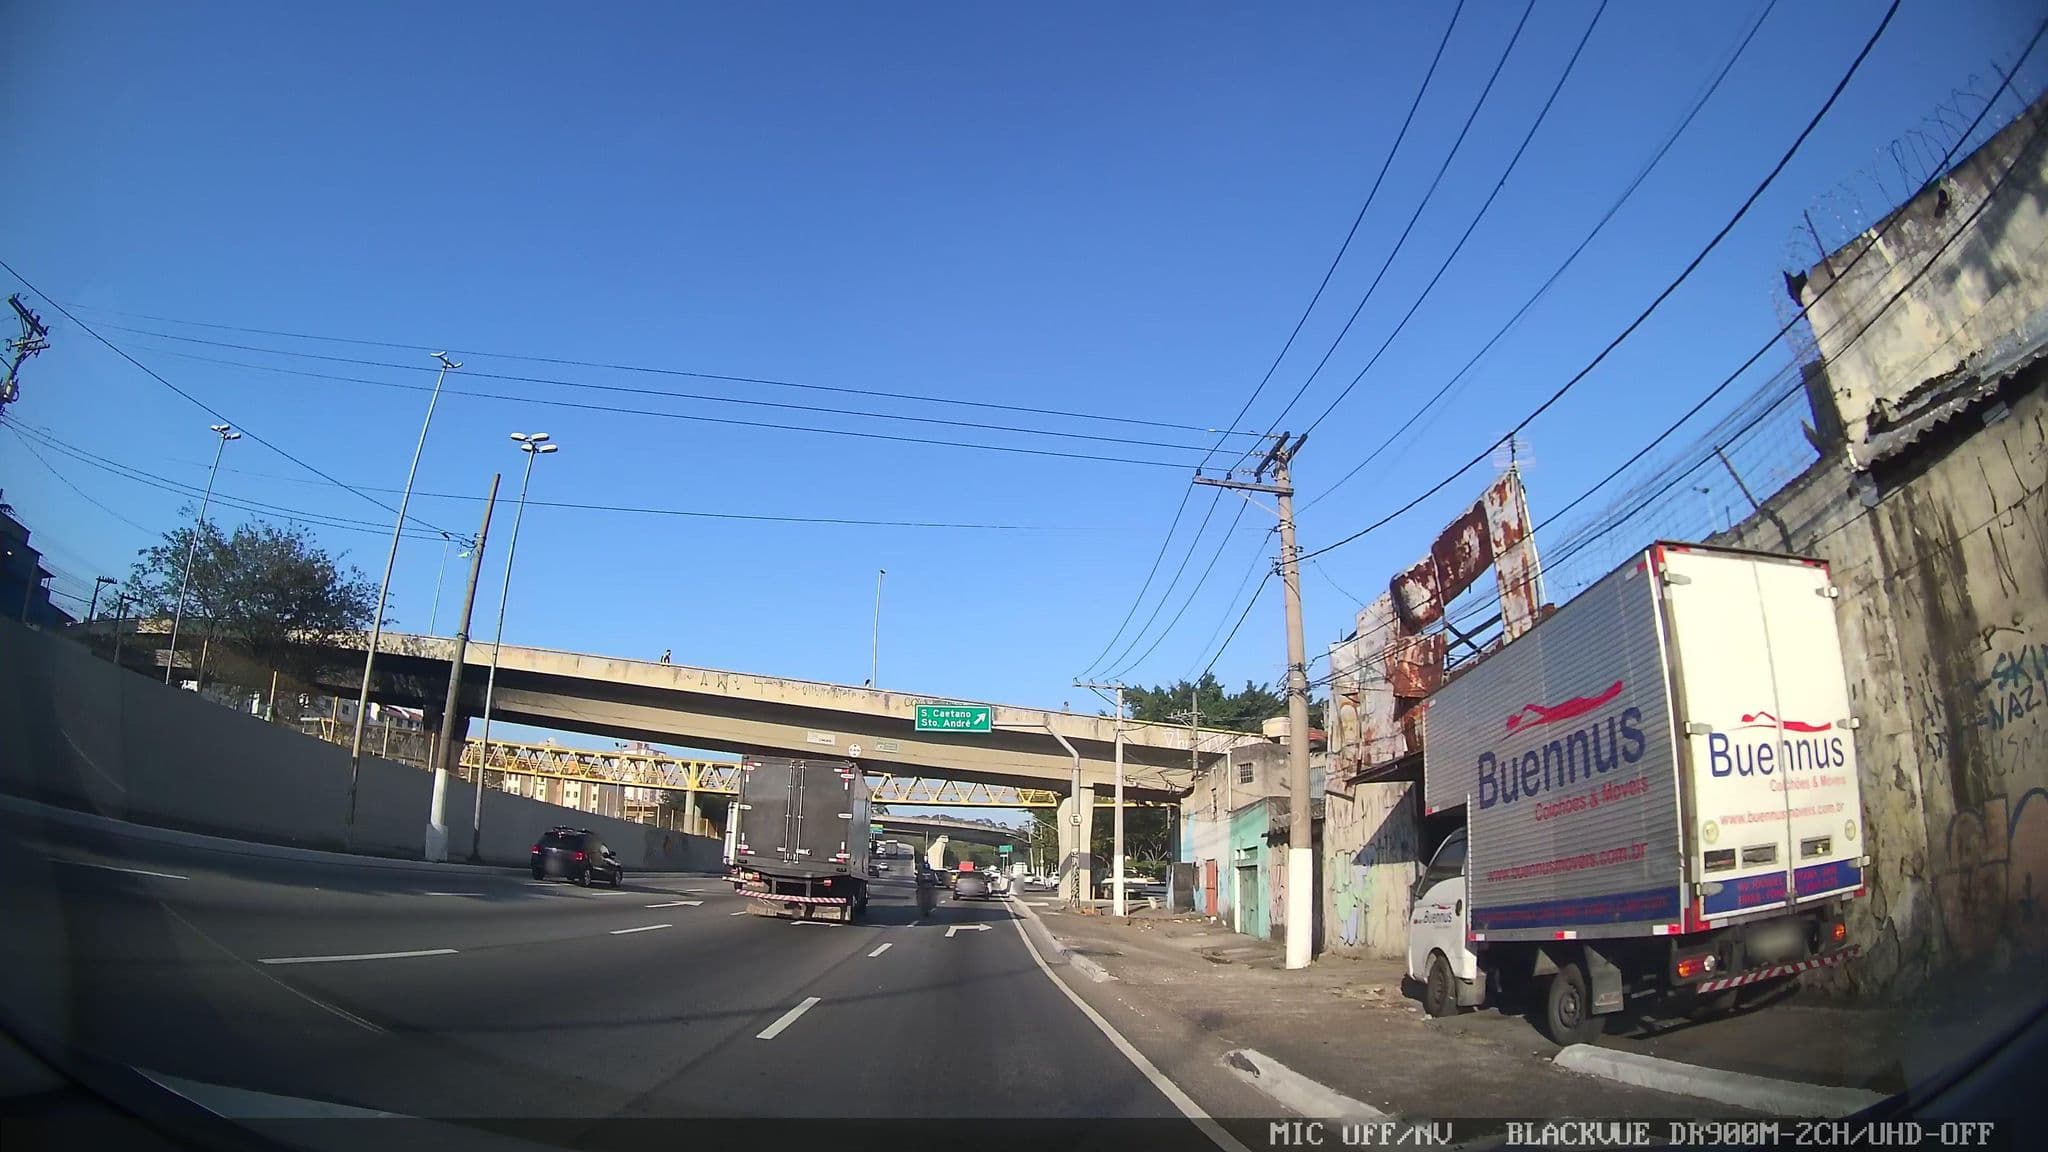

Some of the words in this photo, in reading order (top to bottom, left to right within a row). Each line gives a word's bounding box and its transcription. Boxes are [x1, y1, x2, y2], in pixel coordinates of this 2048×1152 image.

[921, 709, 930, 718] S.
[933, 709, 971, 718] Caetano
[921, 719, 940, 728] Sto.
[943, 719, 971, 728] André
[1478, 706, 1645, 809] Buennus
[1709, 732, 1845, 777] Buennus
